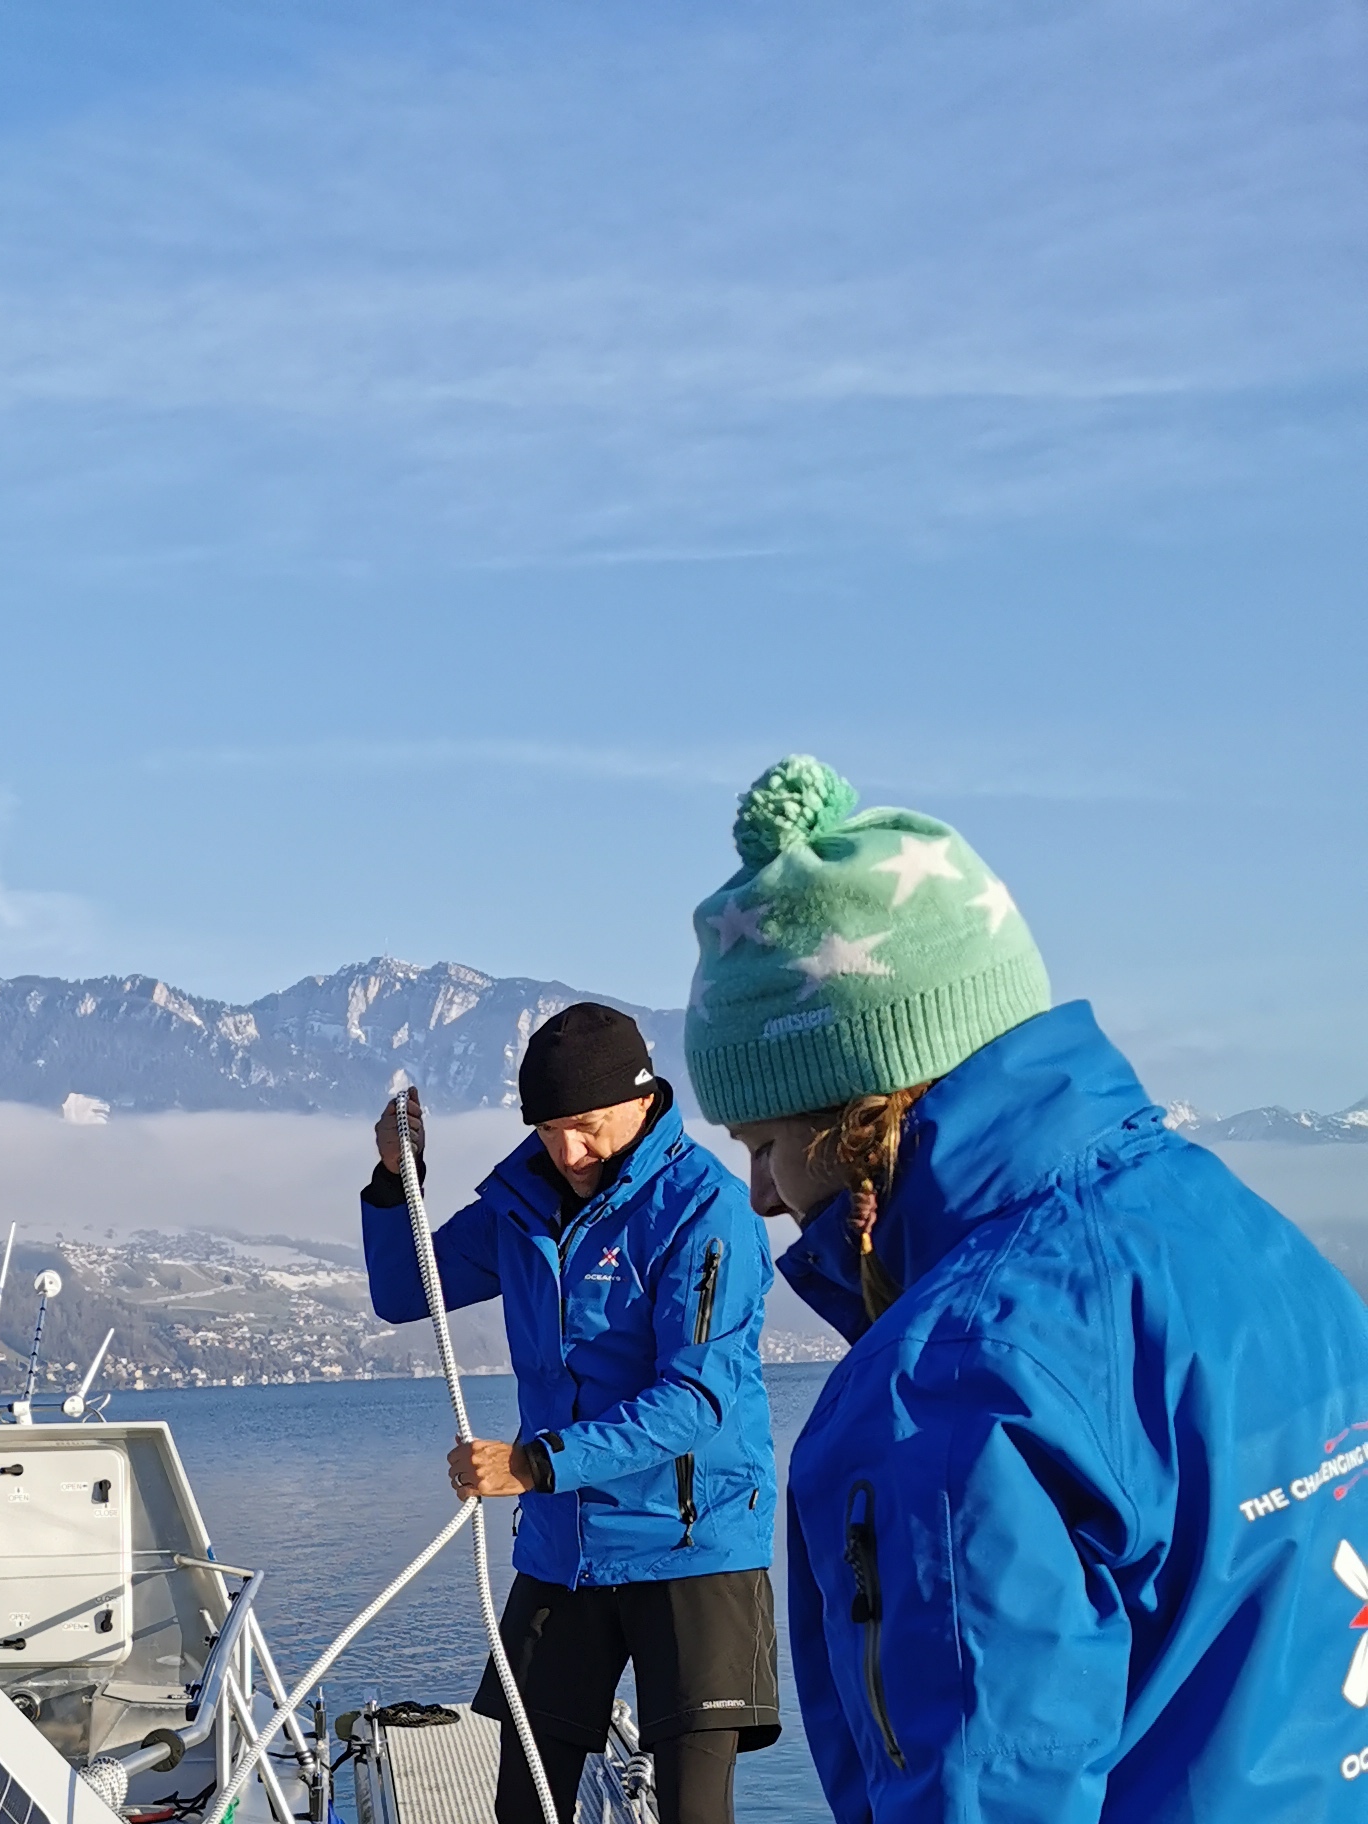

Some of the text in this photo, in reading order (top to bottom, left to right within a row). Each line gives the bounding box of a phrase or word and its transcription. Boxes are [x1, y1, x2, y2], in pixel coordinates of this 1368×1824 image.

[8, 1494, 29, 1502] OPEN
[1239, 1487, 1290, 1521] THE
[9, 1613, 30, 1621] OPEN
[702, 1699, 746, 1710] SHIMANO
